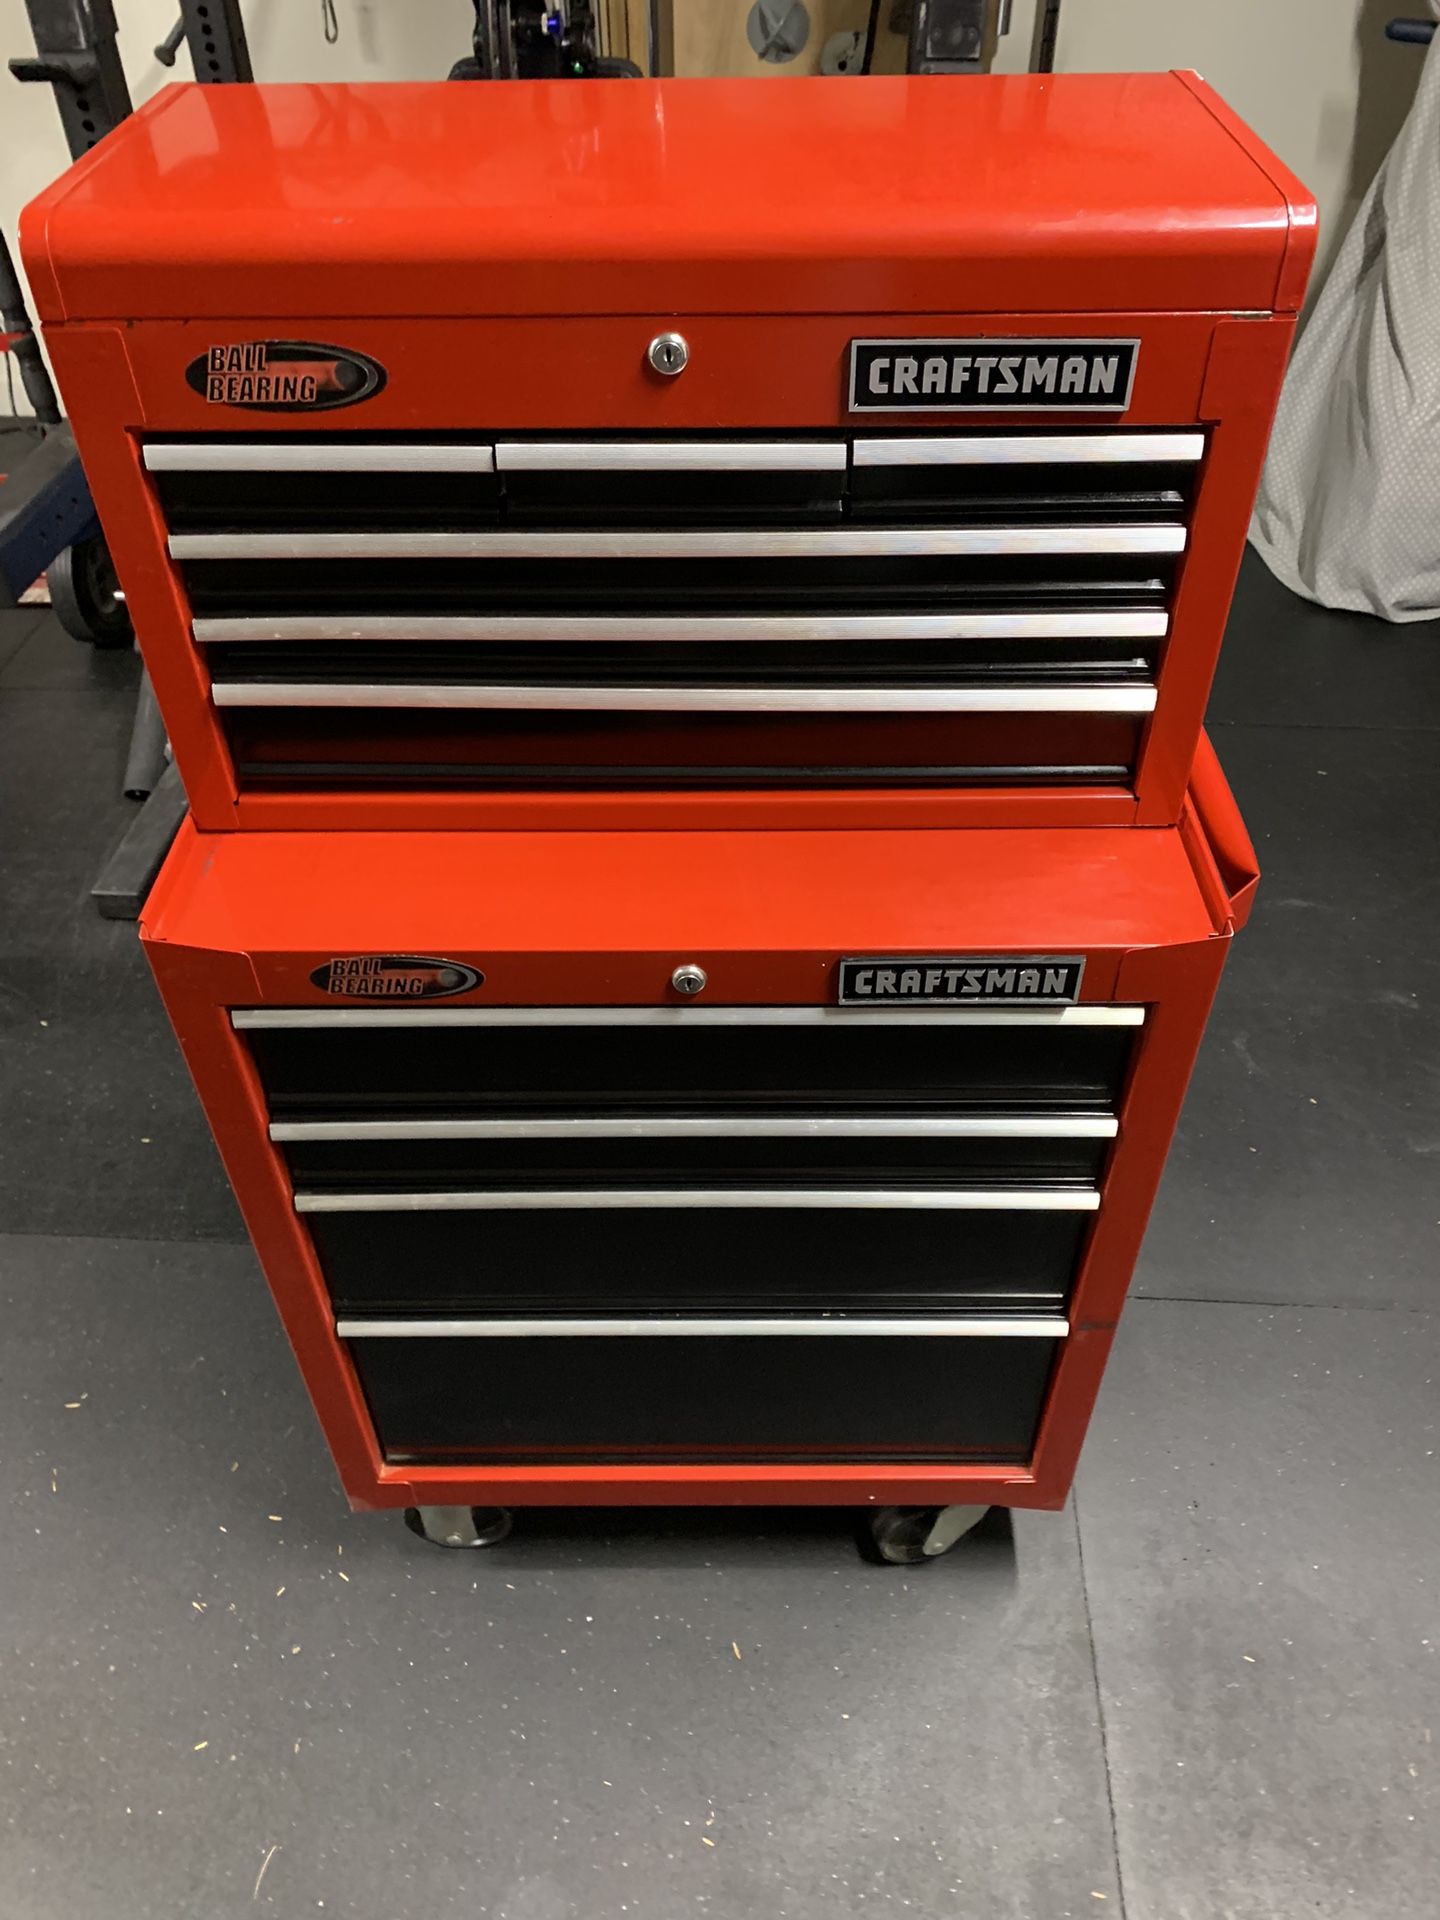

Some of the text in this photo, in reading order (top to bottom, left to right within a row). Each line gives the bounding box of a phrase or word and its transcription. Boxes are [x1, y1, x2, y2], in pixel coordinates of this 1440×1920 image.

[208, 345, 267, 373] BALL
[869, 356, 1118, 394] CRAFTSMAN
[207, 374, 317, 403] BEARING
[330, 958, 382, 976] BALL
[328, 976, 424, 995] BEARING
[855, 969, 1068, 994] CRAFTSMAN
